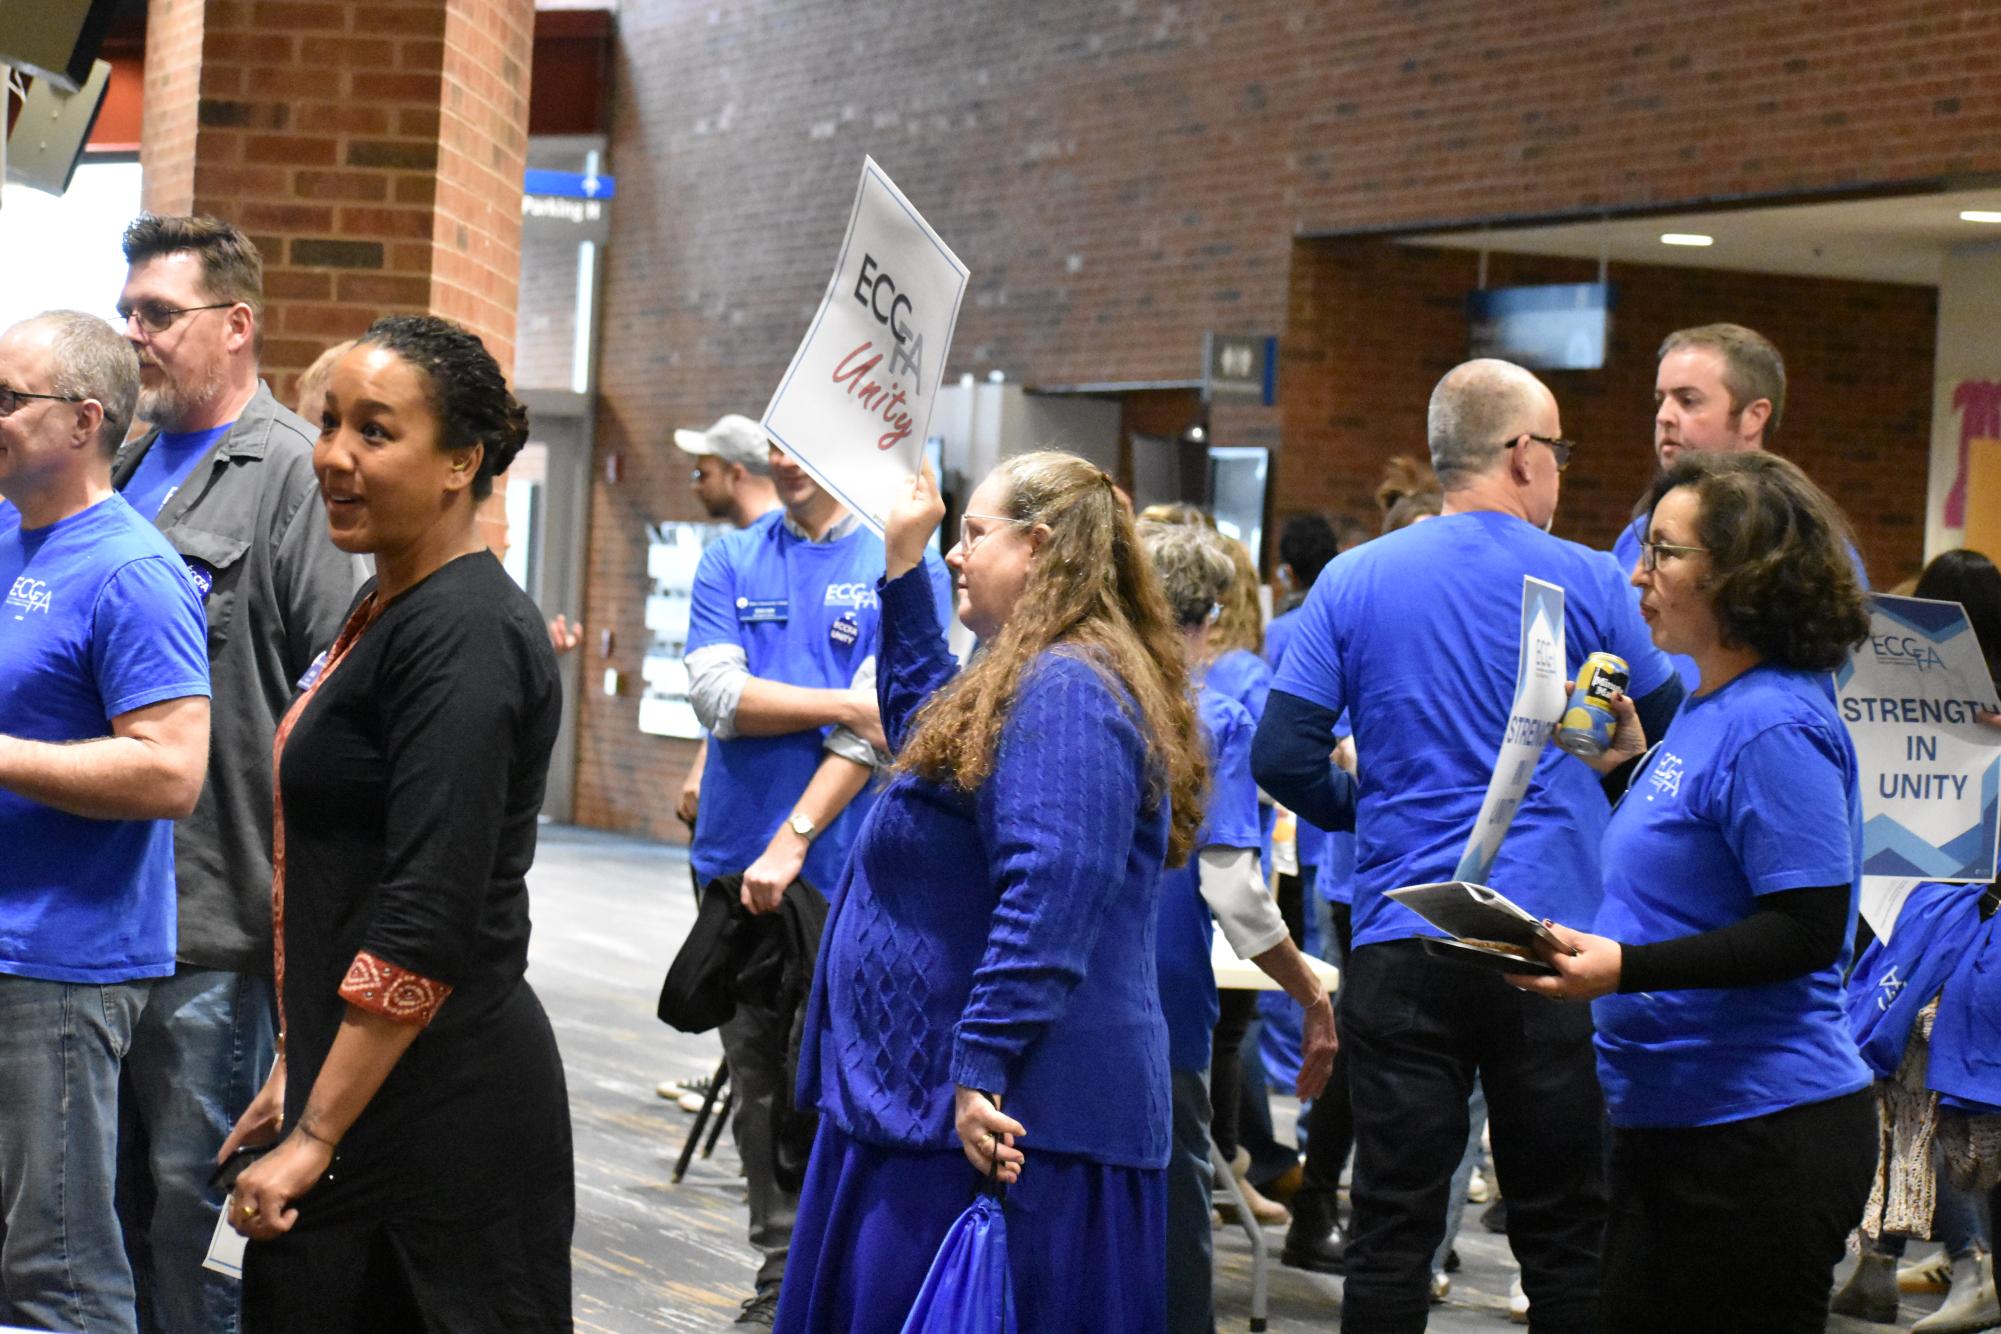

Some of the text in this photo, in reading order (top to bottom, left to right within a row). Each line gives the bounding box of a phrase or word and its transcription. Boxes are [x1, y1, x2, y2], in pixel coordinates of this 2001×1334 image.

[832, 341, 913, 451] Unity
[1907, 735, 1936, 761] IN
[1880, 773, 1968, 800] UNITY
